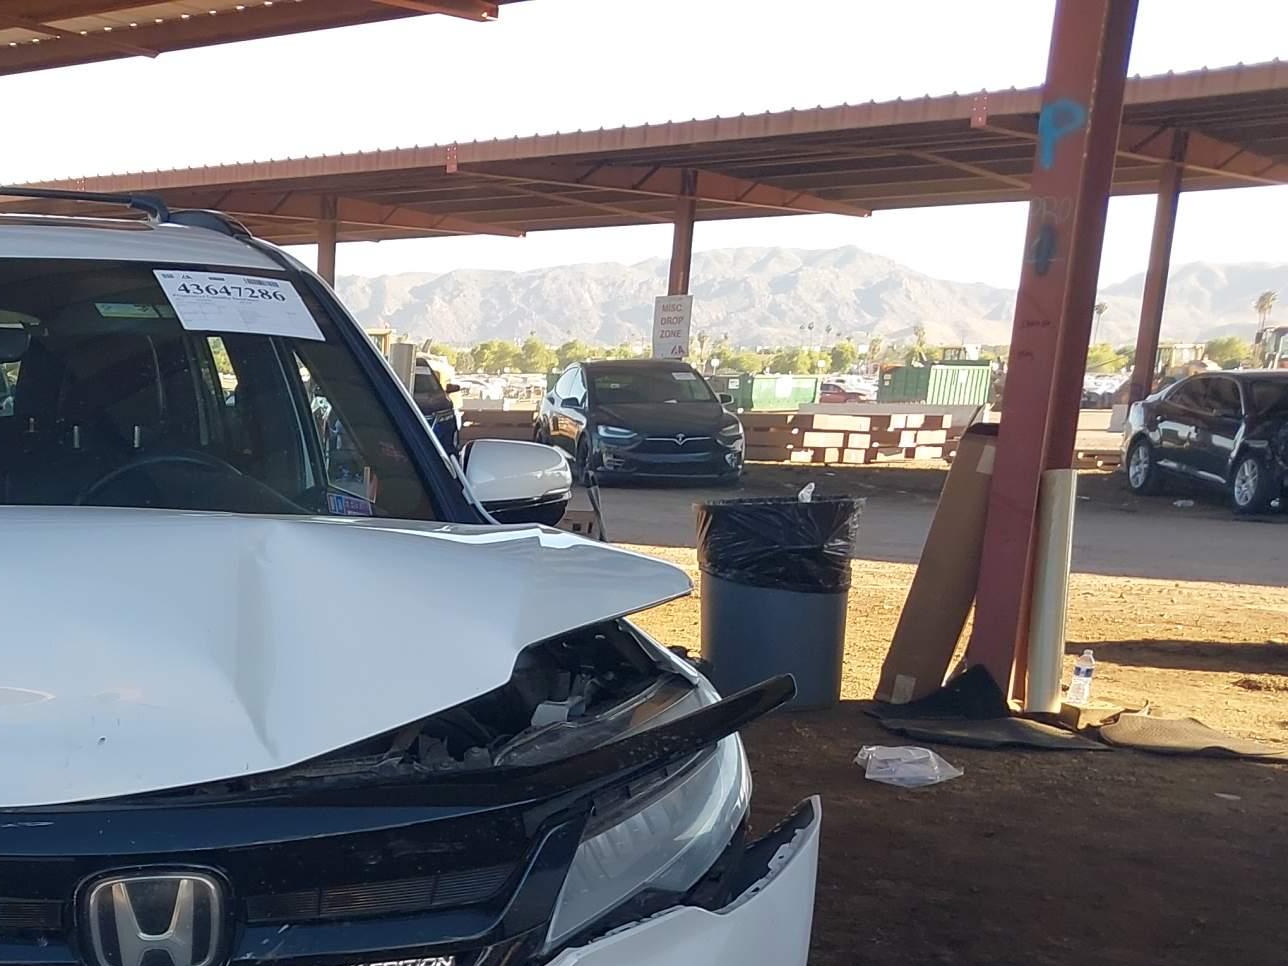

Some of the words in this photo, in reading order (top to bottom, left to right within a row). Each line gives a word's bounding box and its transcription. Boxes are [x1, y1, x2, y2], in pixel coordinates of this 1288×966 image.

[177, 283, 286, 302] 43647286
[660, 316, 684, 325] DROP
[659, 330, 681, 338] ZONE
